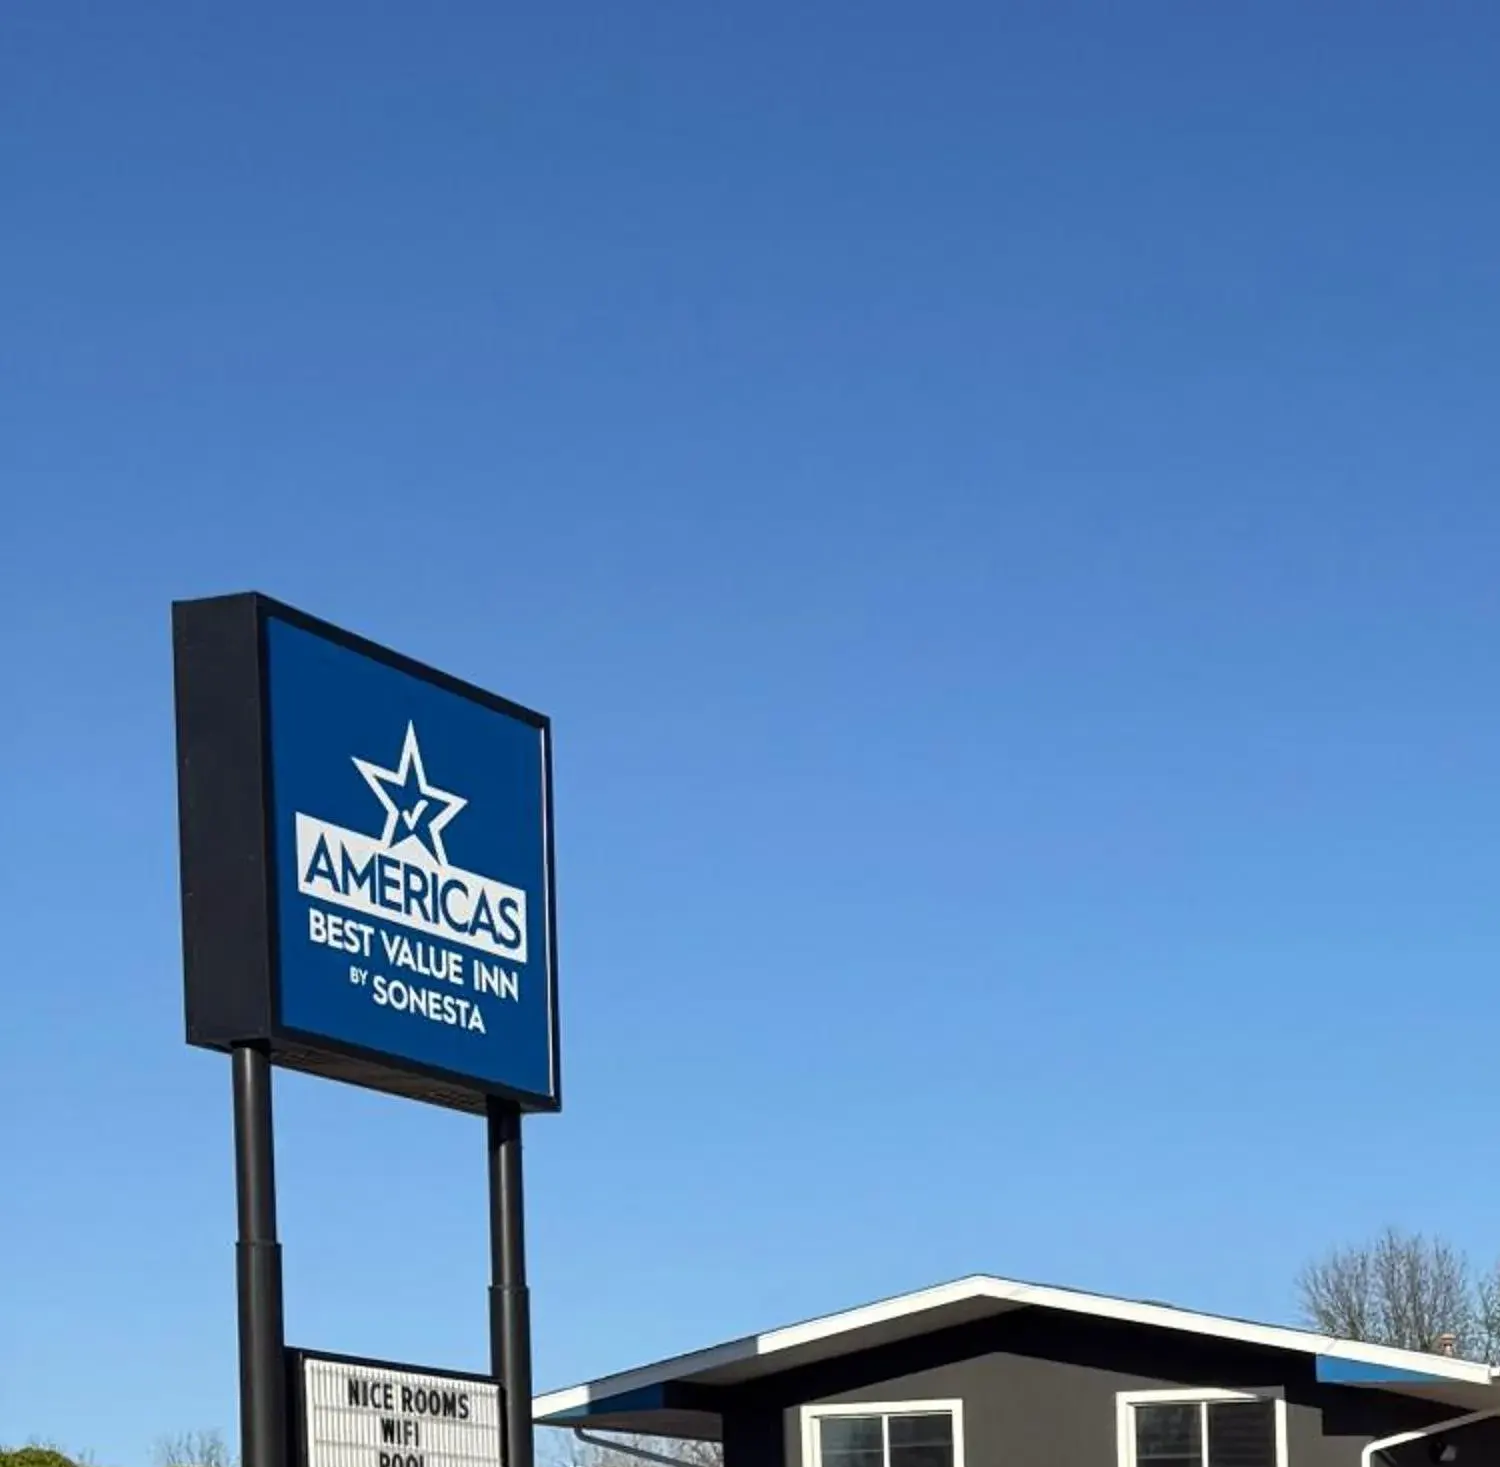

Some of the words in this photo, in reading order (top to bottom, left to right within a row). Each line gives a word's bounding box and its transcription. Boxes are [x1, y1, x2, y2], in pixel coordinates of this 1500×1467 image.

[304, 832, 521, 950] AMERICAS
[309, 908, 375, 957] BEST
[380, 930, 464, 985] VALUE
[473, 960, 519, 1002] INN
[350, 966, 368, 986] BY
[373, 975, 486, 1034] SONESTA
[349, 1380, 394, 1410] NICE
[402, 1385, 469, 1419] ROOMS
[381, 1418, 419, 1447] WIFI
